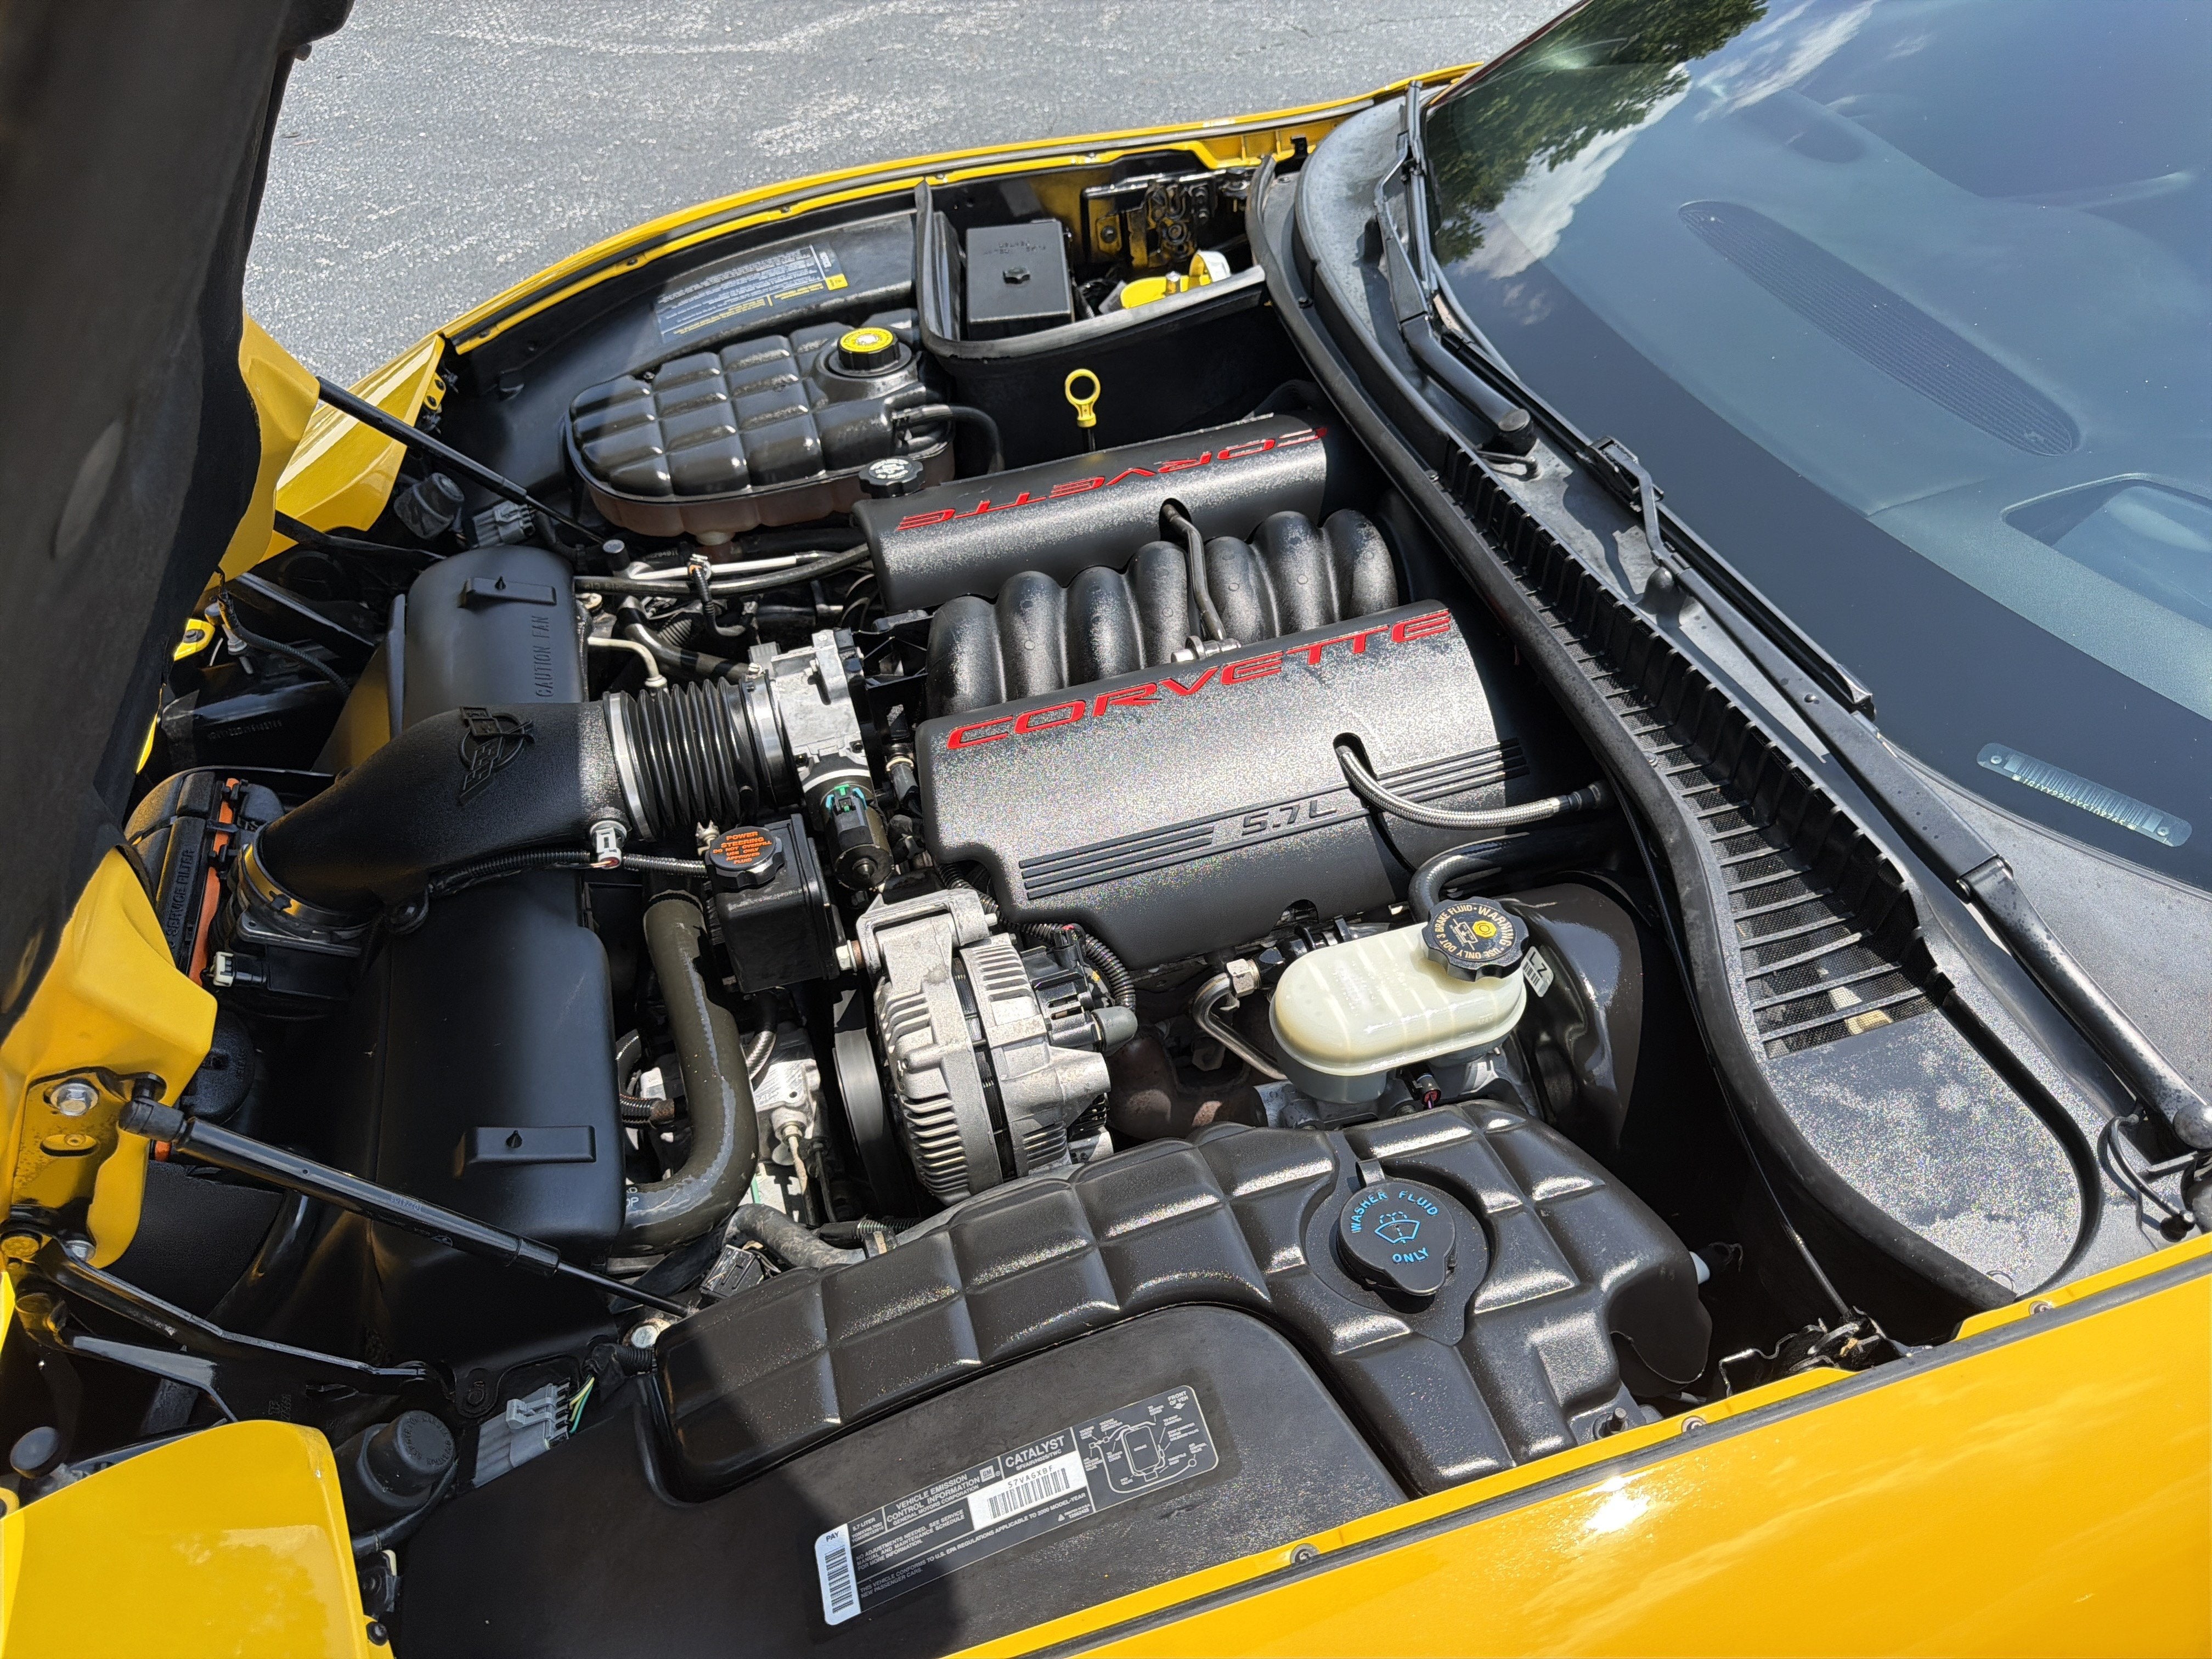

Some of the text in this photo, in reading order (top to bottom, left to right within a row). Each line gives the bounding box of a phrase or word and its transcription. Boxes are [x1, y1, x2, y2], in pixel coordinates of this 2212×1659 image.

[896, 427, 1327, 531] CORVETTE
[532, 615, 554, 697] CAUTION FAN
[946, 610, 1451, 750] CORVETTE
[720, 837, 765, 848] STEERING
[726, 831, 758, 841] POWER
[742, 840, 772, 849] OVERFILL
[726, 852, 760, 861] APPROVED
[165, 886, 187, 936] SERVICE
[176, 849, 195, 885] FILTER
[1447, 904, 1473, 916] FLUID
[1434, 912, 1451, 933] BRAKE
[1477, 906, 1514, 946] WARNING
[1439, 940, 1458, 953] DOT
[1456, 951, 1482, 960] ONLY
[1483, 947, 1502, 958] USE
[1351, 1190, 1438, 1233] WASHER FLUID
[1392, 1247, 1429, 1263] ONLY
[1167, 1390, 1186, 1401] FRONT
[1005, 1435, 1064, 1468] CATALYST
[982, 1468, 992, 1477] GM
[886, 1476, 980, 1522] CONTROL INFORMATION
[895, 1474, 967, 1510] VEHICLE EMISSION
[892, 1483, 979, 1526] GENERAL MOTORS CORPORATION
[860, 1516, 876, 1527] LITER
[865, 1536, 903, 1555] ADJUSTMENTS
[903, 1526, 927, 1539] NEEDED.
[928, 1519, 940, 1528] SEE
[940, 1509, 963, 1523] SERVICE
[825, 1531, 840, 1543] PAY
[856, 1514, 965, 1565] MANUAL AND MAINTENANCE SCHEDULE
[859, 1583, 872, 1593] THIS
[872, 1573, 895, 1587] VEHICLE
[895, 1559, 926, 1577] CONFORMS
[934, 1551, 946, 1559] U.S.
[945, 1545, 957, 1554] EPA
[957, 1529, 995, 1549] REGULATIONS
[994, 1515, 1029, 1533] APPLICABLE
[1049, 1492, 1086, 1510] MODEL-YEAR
[857, 1562, 869, 1571] FOR
[870, 1554, 885, 1565] MORE
[860, 1589, 873, 1599] NEW
[873, 1574, 906, 1592] PASSENGER
